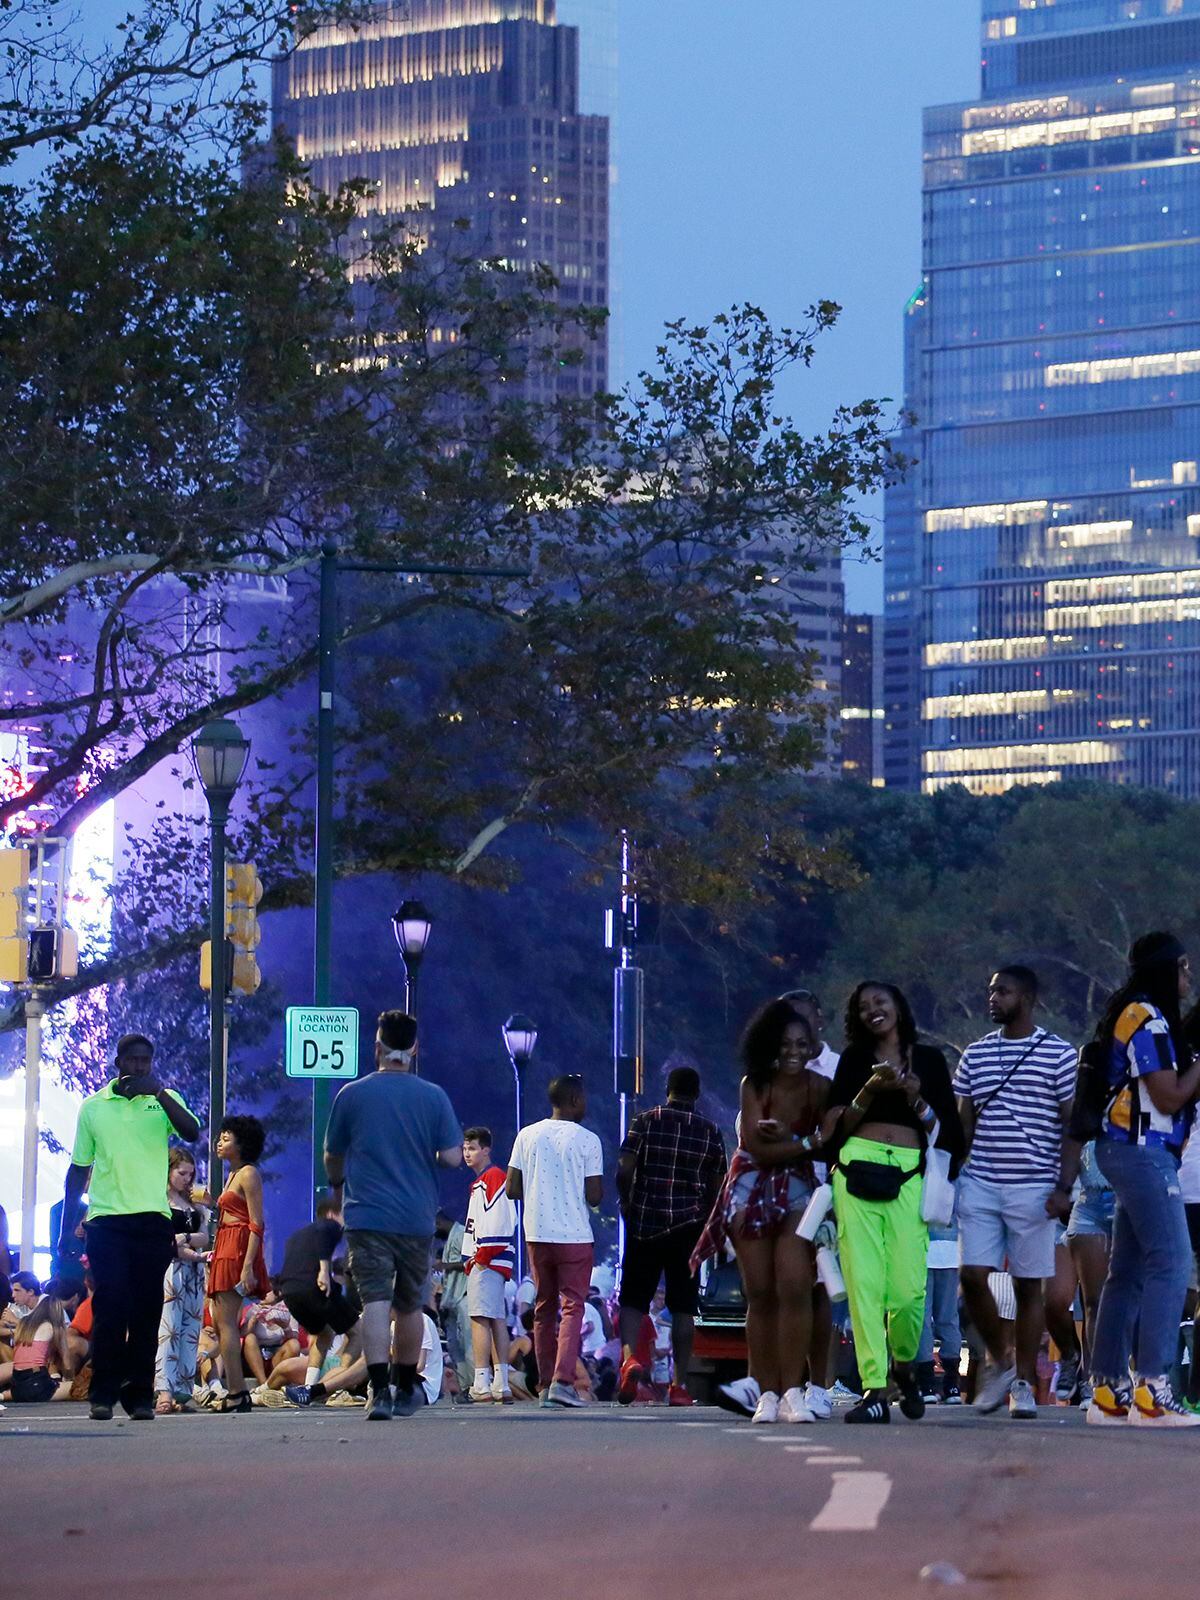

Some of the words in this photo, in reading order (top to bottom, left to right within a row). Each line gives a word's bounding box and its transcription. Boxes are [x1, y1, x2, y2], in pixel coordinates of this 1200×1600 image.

[300, 1014, 347, 1023] PARKWAY
[298, 1024, 349, 1033] LOCATION
[303, 1039, 344, 1070] D-5
